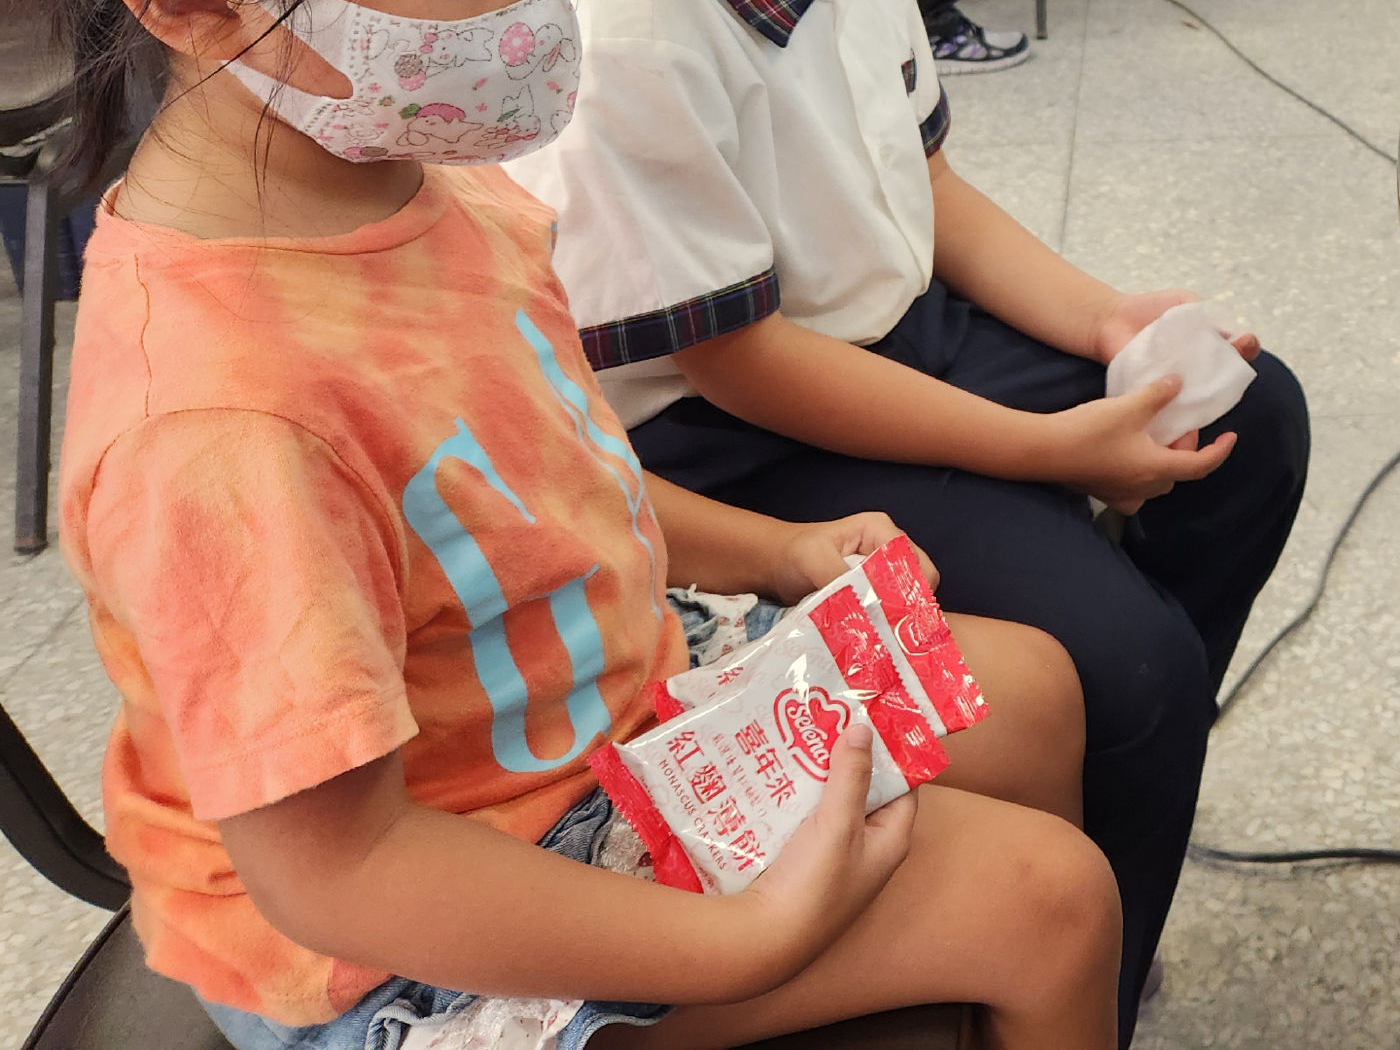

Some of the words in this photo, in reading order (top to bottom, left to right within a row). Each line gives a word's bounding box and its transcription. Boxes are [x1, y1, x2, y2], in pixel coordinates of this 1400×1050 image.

[735, 719, 797, 809] 喜年來
[786, 705, 830, 765] Serena
[659, 759, 697, 816] MONASCUS
[694, 817, 727, 870] CRACKERS
[666, 730, 767, 872] 紅麴薄餅
